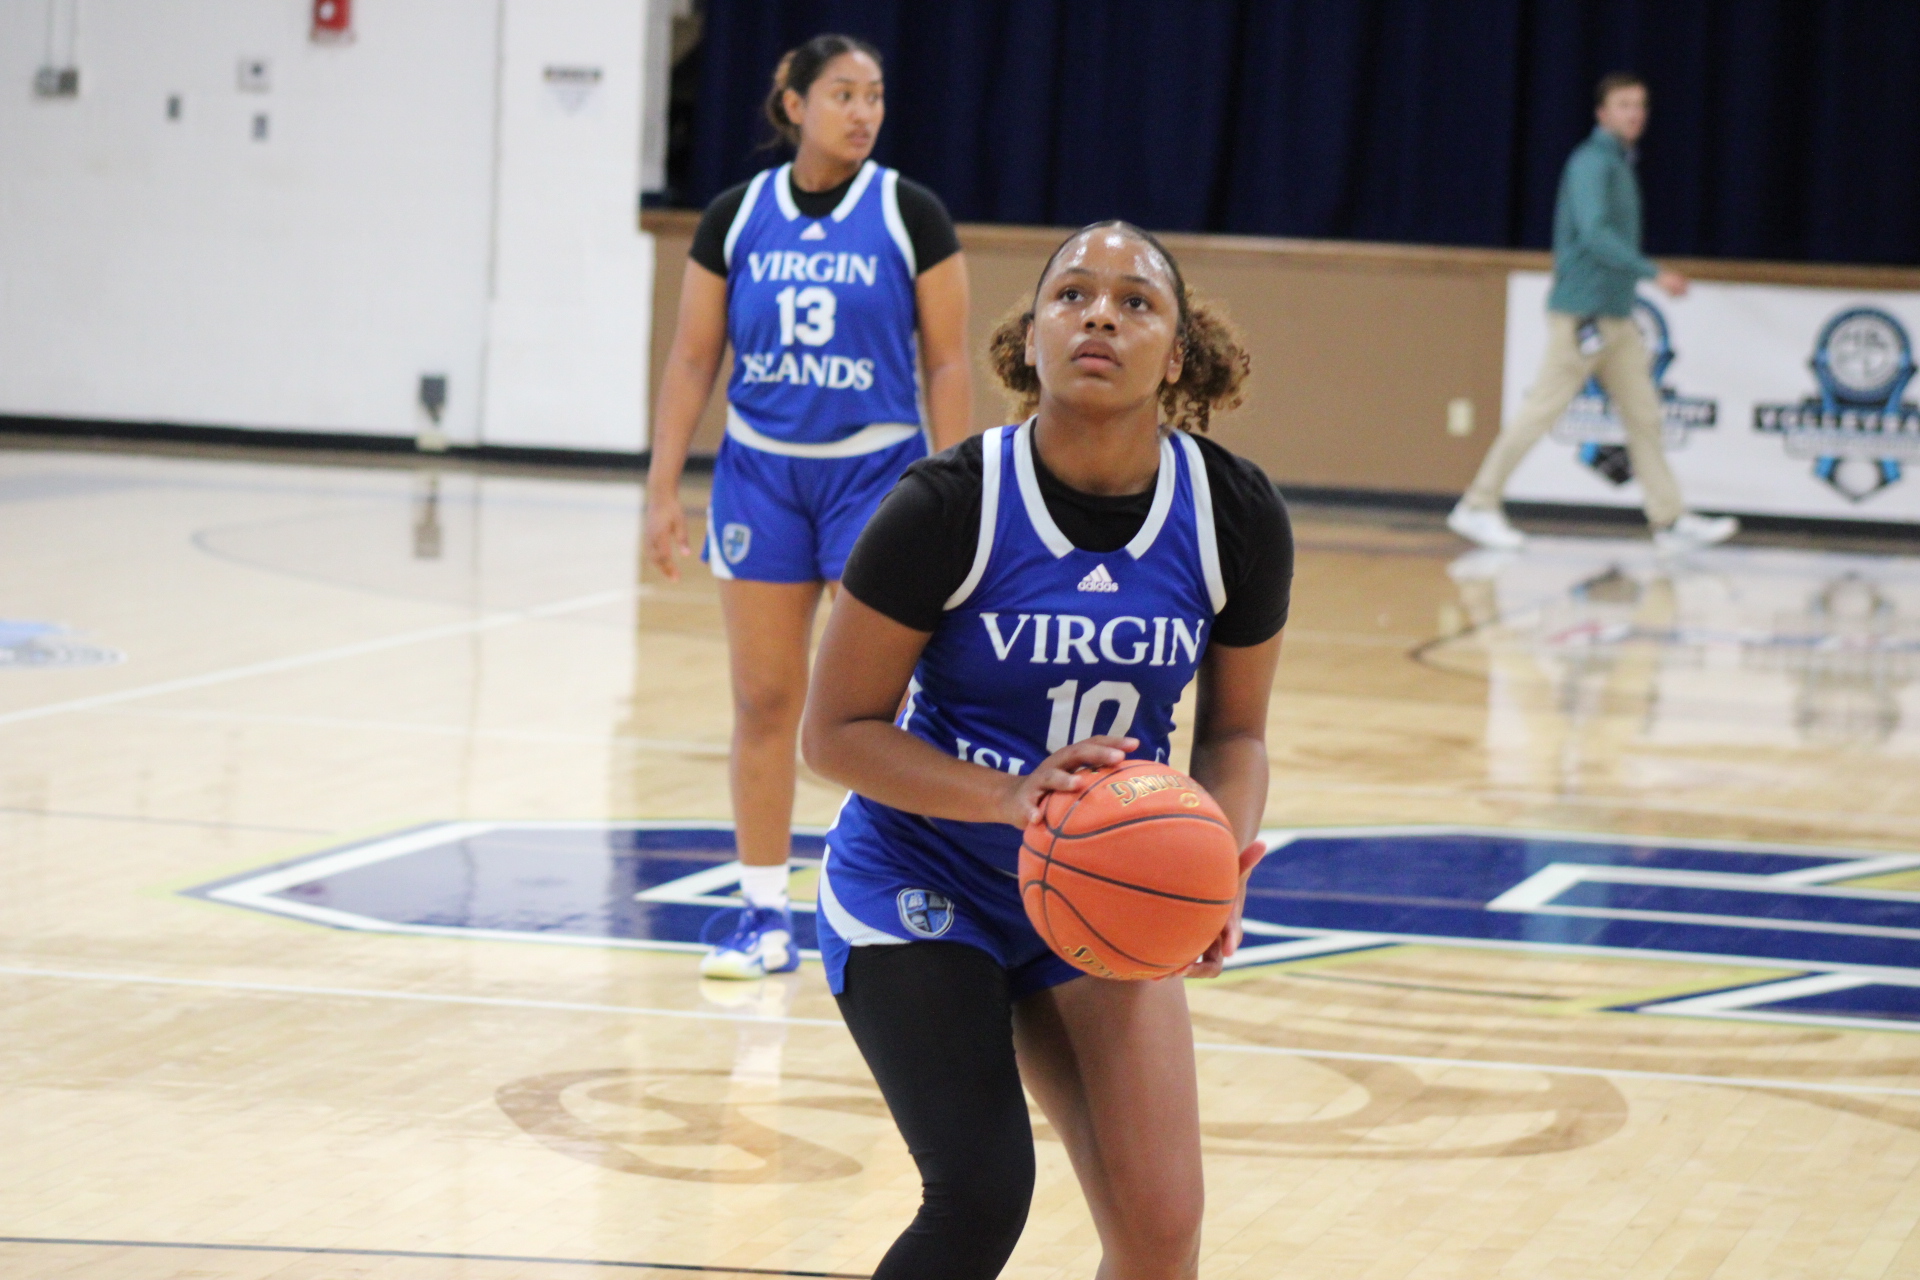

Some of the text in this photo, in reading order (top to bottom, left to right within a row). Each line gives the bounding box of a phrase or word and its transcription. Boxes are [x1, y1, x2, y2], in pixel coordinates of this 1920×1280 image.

[748, 251, 878, 286] VIRGIN
[776, 286, 836, 346] 13
[742, 352, 875, 391] ISLANDS
[1077, 579, 1119, 593] adidas
[979, 612, 1205, 666] VIRGIN
[1046, 679, 1141, 755] 10
